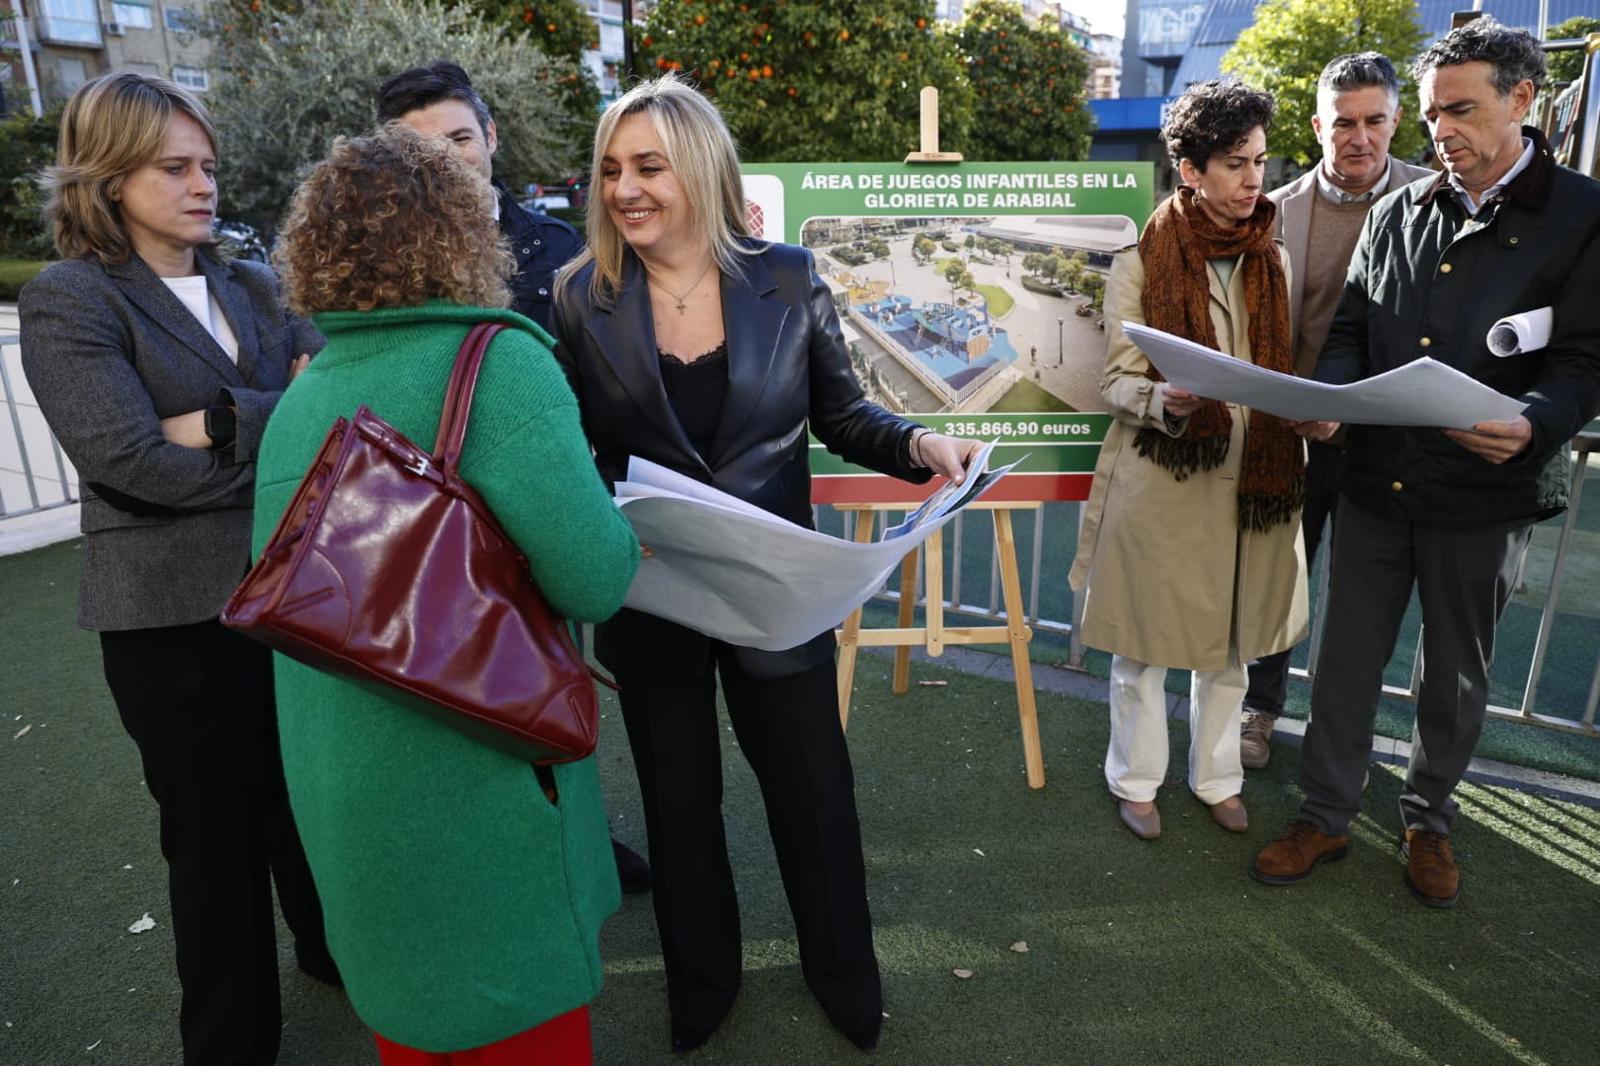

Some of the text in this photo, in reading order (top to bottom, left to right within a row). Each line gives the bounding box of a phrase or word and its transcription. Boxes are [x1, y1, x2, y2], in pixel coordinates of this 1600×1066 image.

[801, 171, 1138, 190] ÁREA DE JUEGOS INFANTILES EN LA
[864, 192, 1077, 209] GLORIETA DE ARABIAL
[944, 421, 1039, 437] 335.866,90
[1042, 423, 1091, 436] euros
